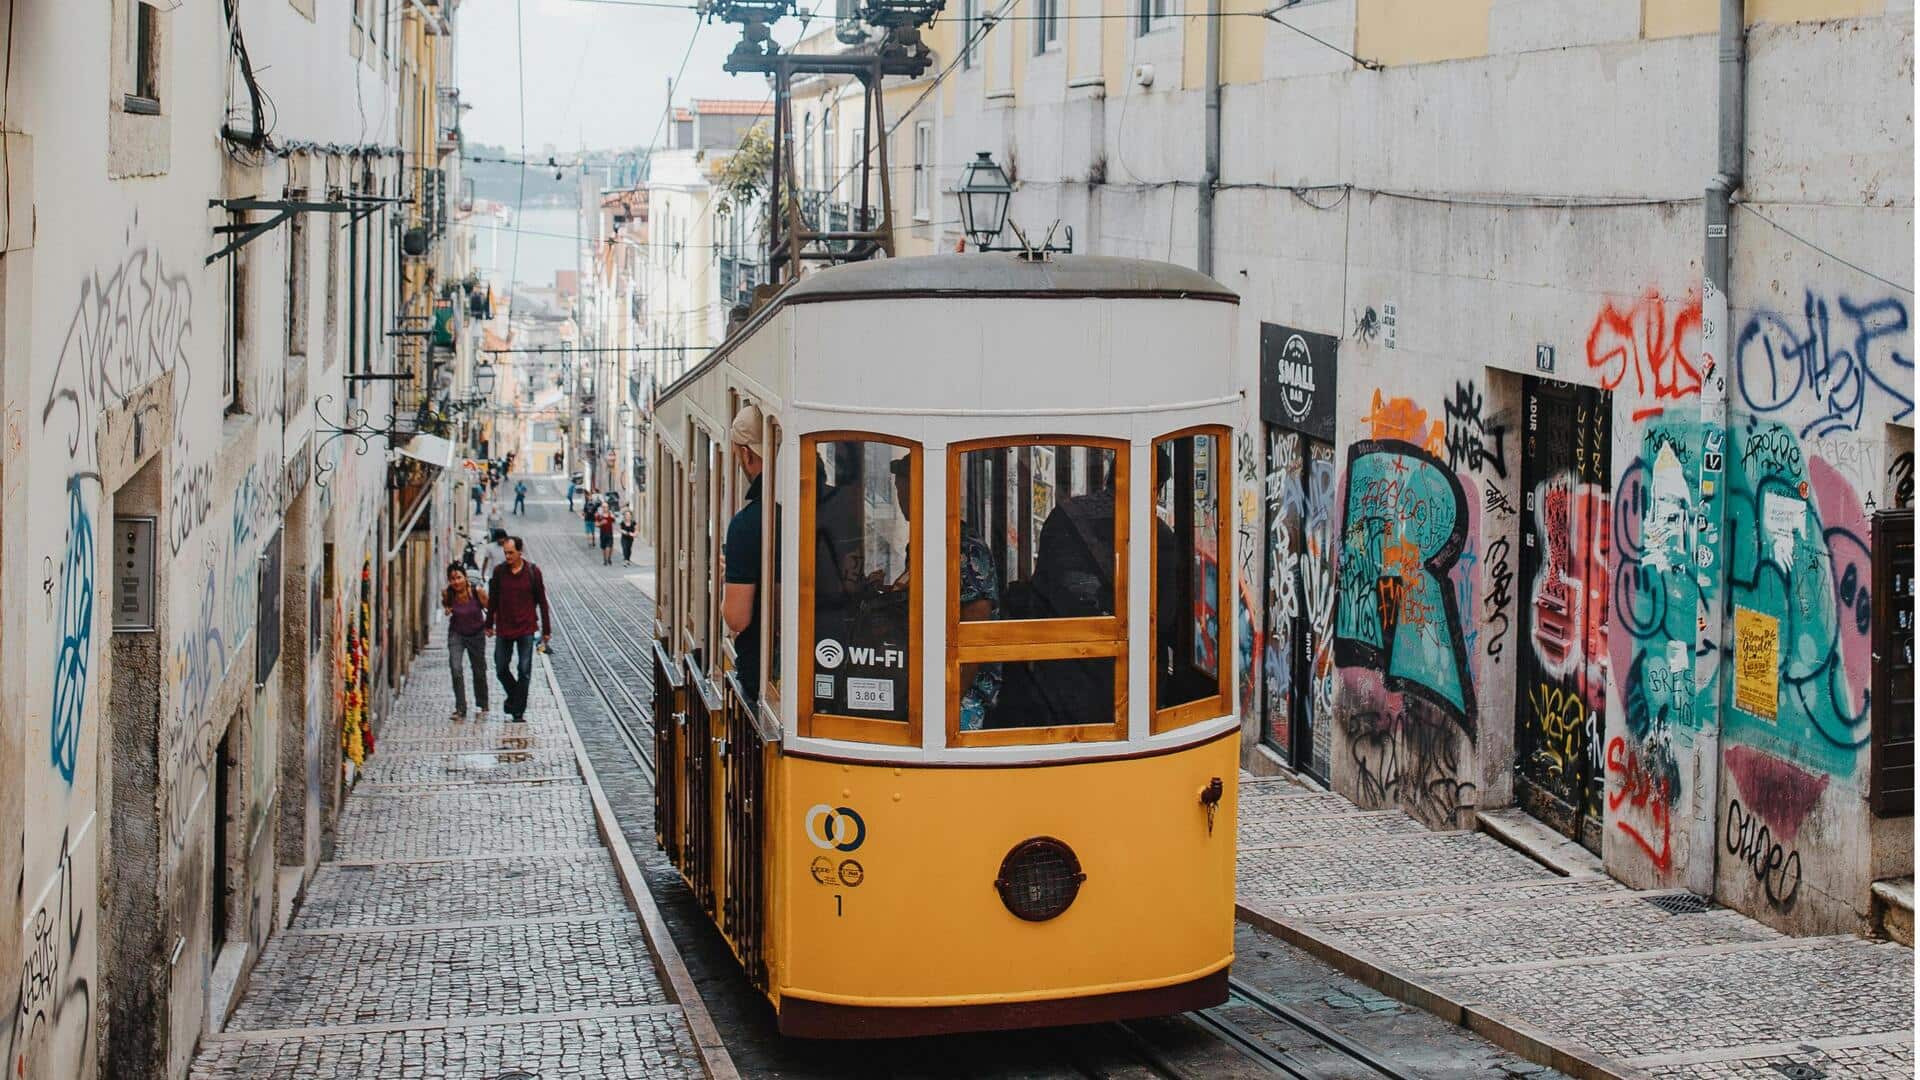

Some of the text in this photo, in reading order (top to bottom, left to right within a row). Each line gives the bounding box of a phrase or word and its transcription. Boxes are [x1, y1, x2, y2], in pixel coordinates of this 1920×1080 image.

[1278, 358, 1315, 392] SMALL
[1289, 387, 1304, 404] BAR
[1529, 396, 1538, 431] ADUR
[848, 646, 904, 669] WI-FI
[834, 894, 842, 917] 1
